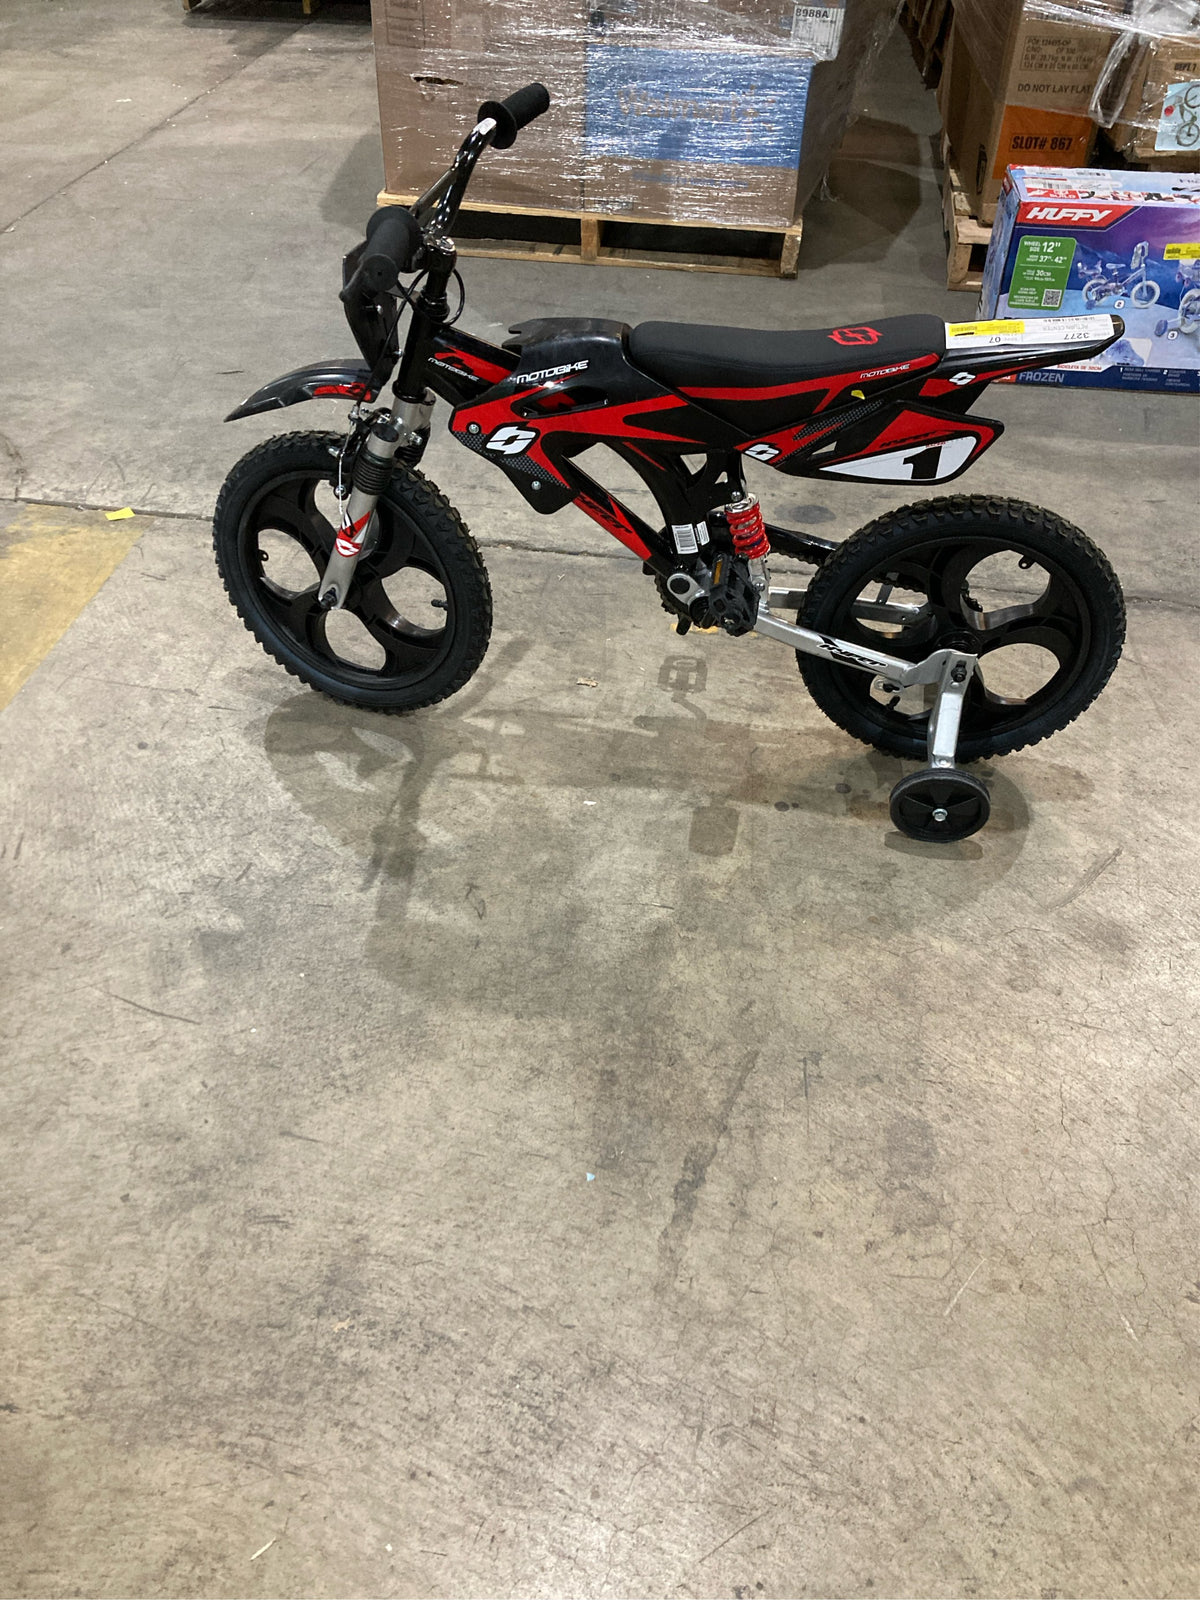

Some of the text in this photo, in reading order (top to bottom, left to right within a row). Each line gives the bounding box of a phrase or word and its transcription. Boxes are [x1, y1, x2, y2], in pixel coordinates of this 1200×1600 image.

[1017, 83, 1092, 94] DO NOT LAY FLAT
[1012, 135, 1073, 151] SLOT# 867
[1026, 207, 1113, 223] HUFFY
[989, 336, 1001, 344] 07
[1064, 332, 1090, 340] 3277
[427, 356, 479, 382] MOTOBIKE
[516, 359, 589, 385] MOTOBIKE
[860, 363, 911, 379] MOTOBIKE
[1019, 371, 1065, 383] FROZEN
[903, 446, 943, 480] 1
